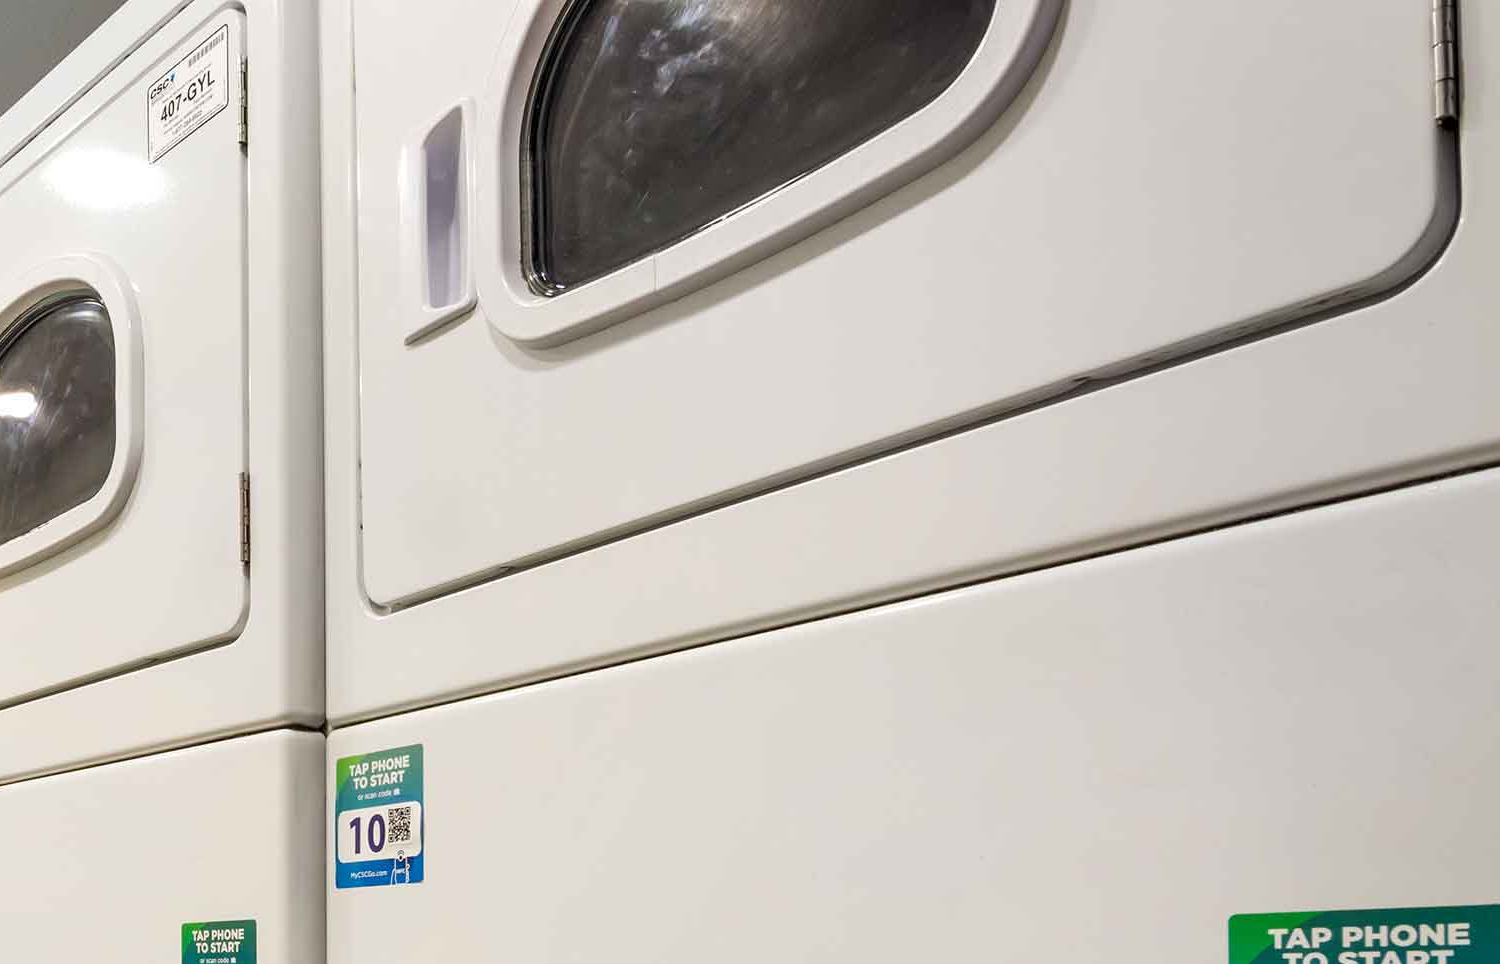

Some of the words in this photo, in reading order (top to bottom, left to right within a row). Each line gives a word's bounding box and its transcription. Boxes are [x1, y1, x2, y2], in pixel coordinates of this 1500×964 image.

[150, 78, 169, 100] CSC
[160, 70, 216, 122] 407-GYL
[349, 762, 368, 777] TAP
[371, 755, 410, 772] PHONE
[353, 777, 368, 790] TO
[370, 771, 404, 787] START
[350, 814, 386, 854] 10
[192, 930, 209, 942] TAP
[212, 928, 244, 940] PHONE
[1268, 928, 1332, 949] TAP
[1342, 923, 1470, 948] PHONE
[196, 942, 208, 953] TO
[210, 942, 240, 953] START
